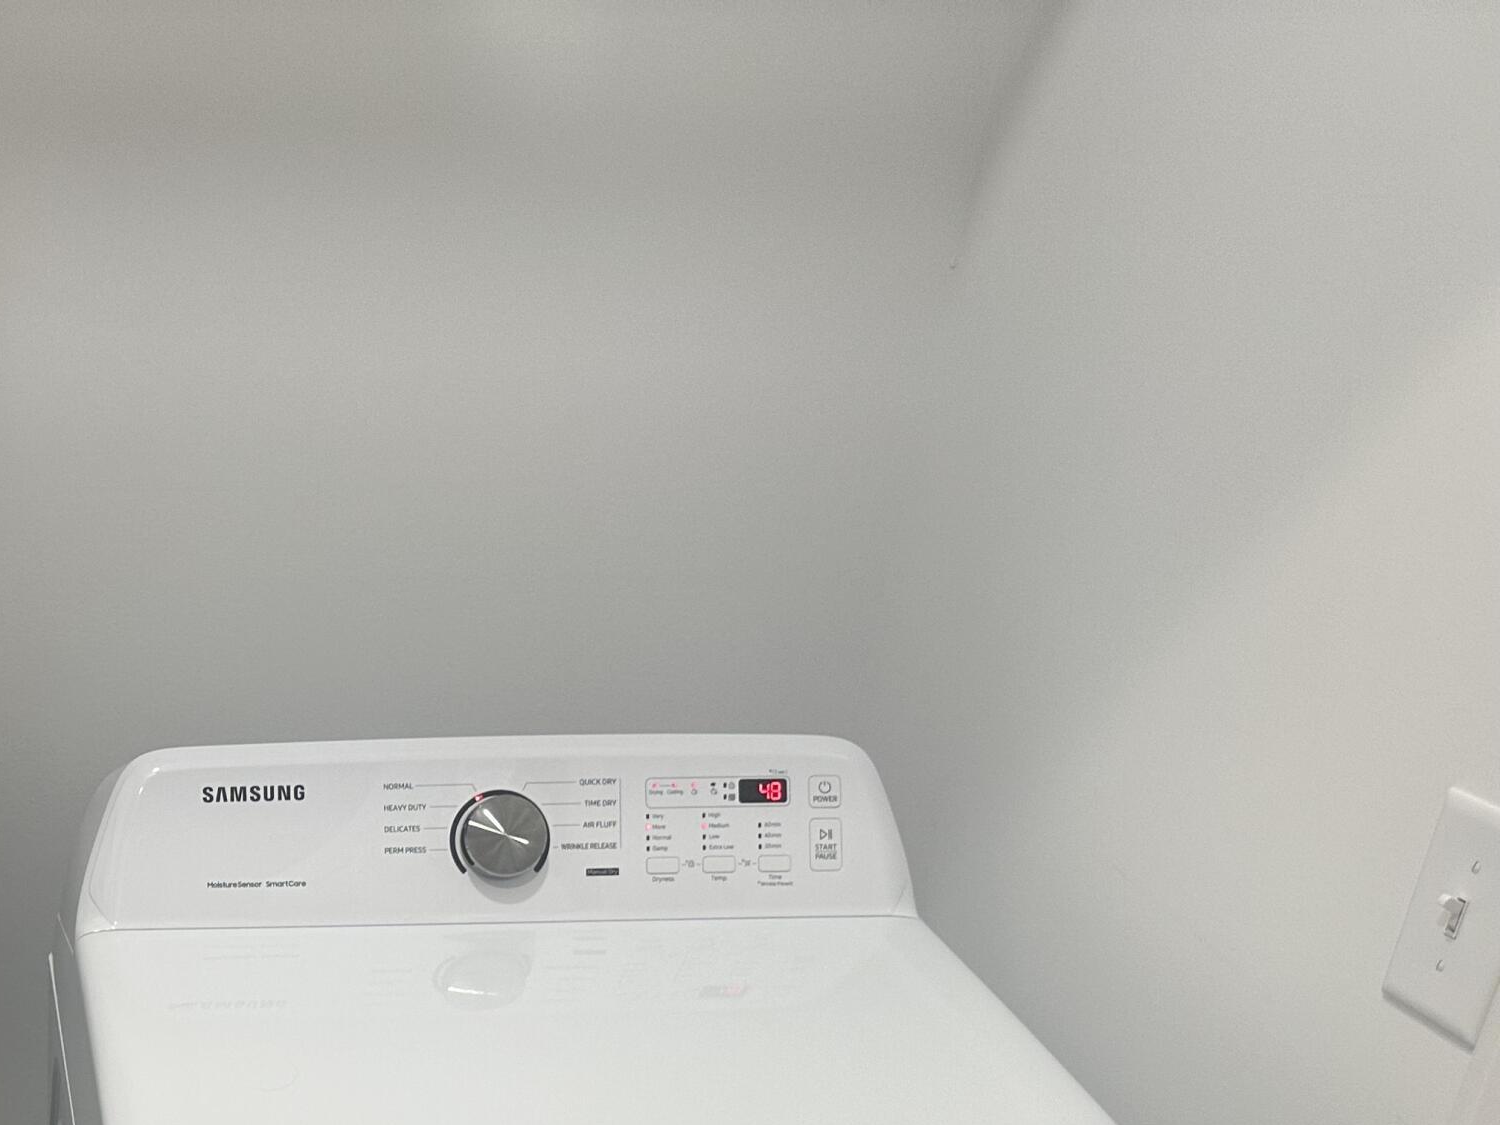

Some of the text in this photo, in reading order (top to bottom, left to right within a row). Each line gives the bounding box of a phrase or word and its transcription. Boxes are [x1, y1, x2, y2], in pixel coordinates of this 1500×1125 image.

[579, 778, 601, 786] QUICK
[383, 783, 413, 791] NORMAL
[759, 781, 782, 801] 48
[202, 784, 306, 803] SAMSUNG
[813, 795, 837, 803] POWER
[383, 803, 427, 812] HEAVY DUTY
[384, 825, 421, 833] DELICATES
[406, 846, 427, 854] PRESS
[590, 842, 617, 850] RELEASE
[814, 852, 837, 860] PAUSE
[207, 879, 307, 888] MoistureSensor SmartCare
